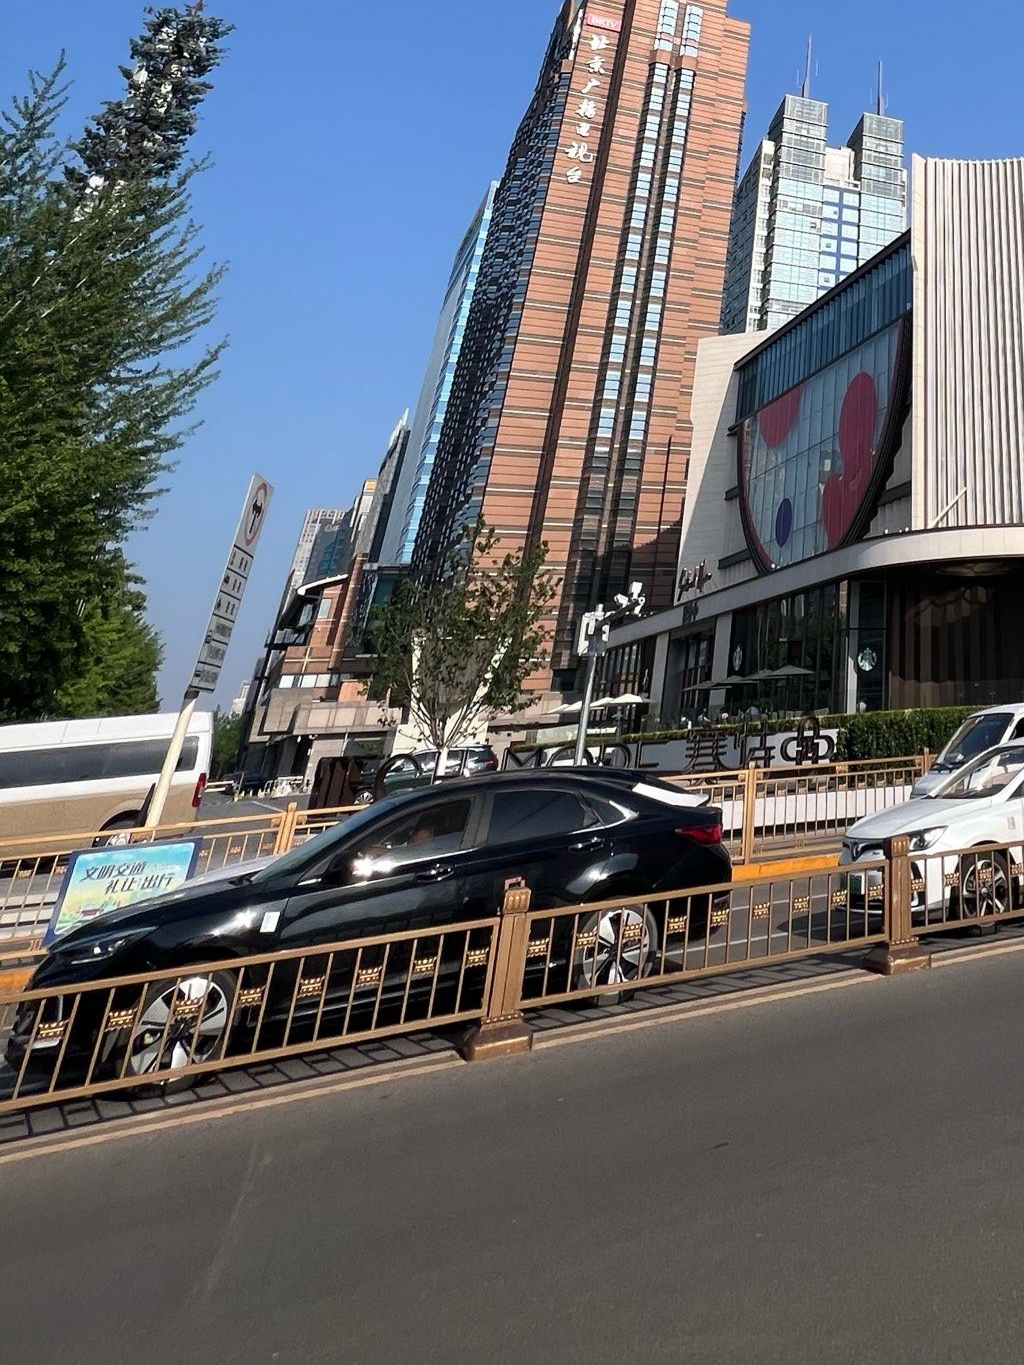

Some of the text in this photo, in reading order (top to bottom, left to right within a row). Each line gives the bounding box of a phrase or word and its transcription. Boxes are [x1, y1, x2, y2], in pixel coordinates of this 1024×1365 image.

[564, 33, 610, 184] 北京广播电视台
[79, 861, 148, 883] 文明交通
